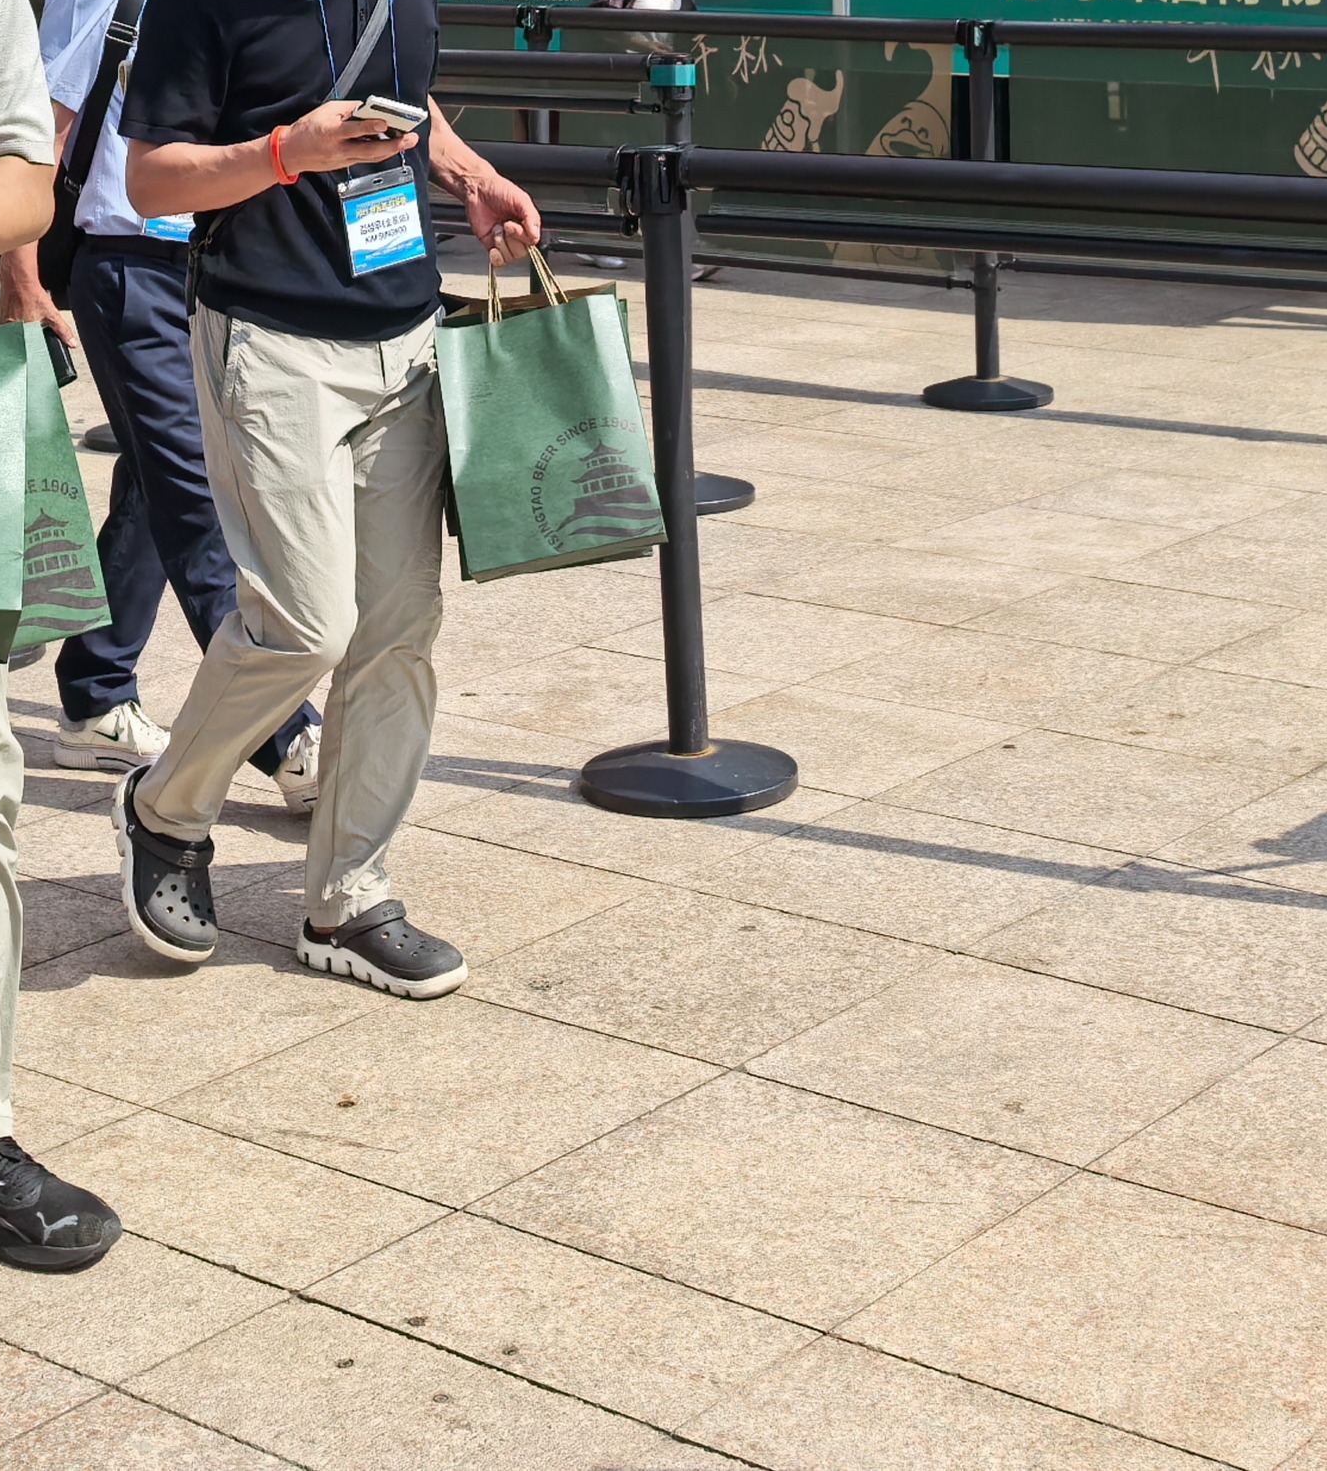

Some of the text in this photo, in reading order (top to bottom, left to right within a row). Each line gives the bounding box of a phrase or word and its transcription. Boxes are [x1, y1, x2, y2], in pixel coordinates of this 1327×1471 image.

[532, 443, 559, 482] BEER
[41, 478, 79, 501] 1903
[530, 485, 566, 556] TSINGTAO
